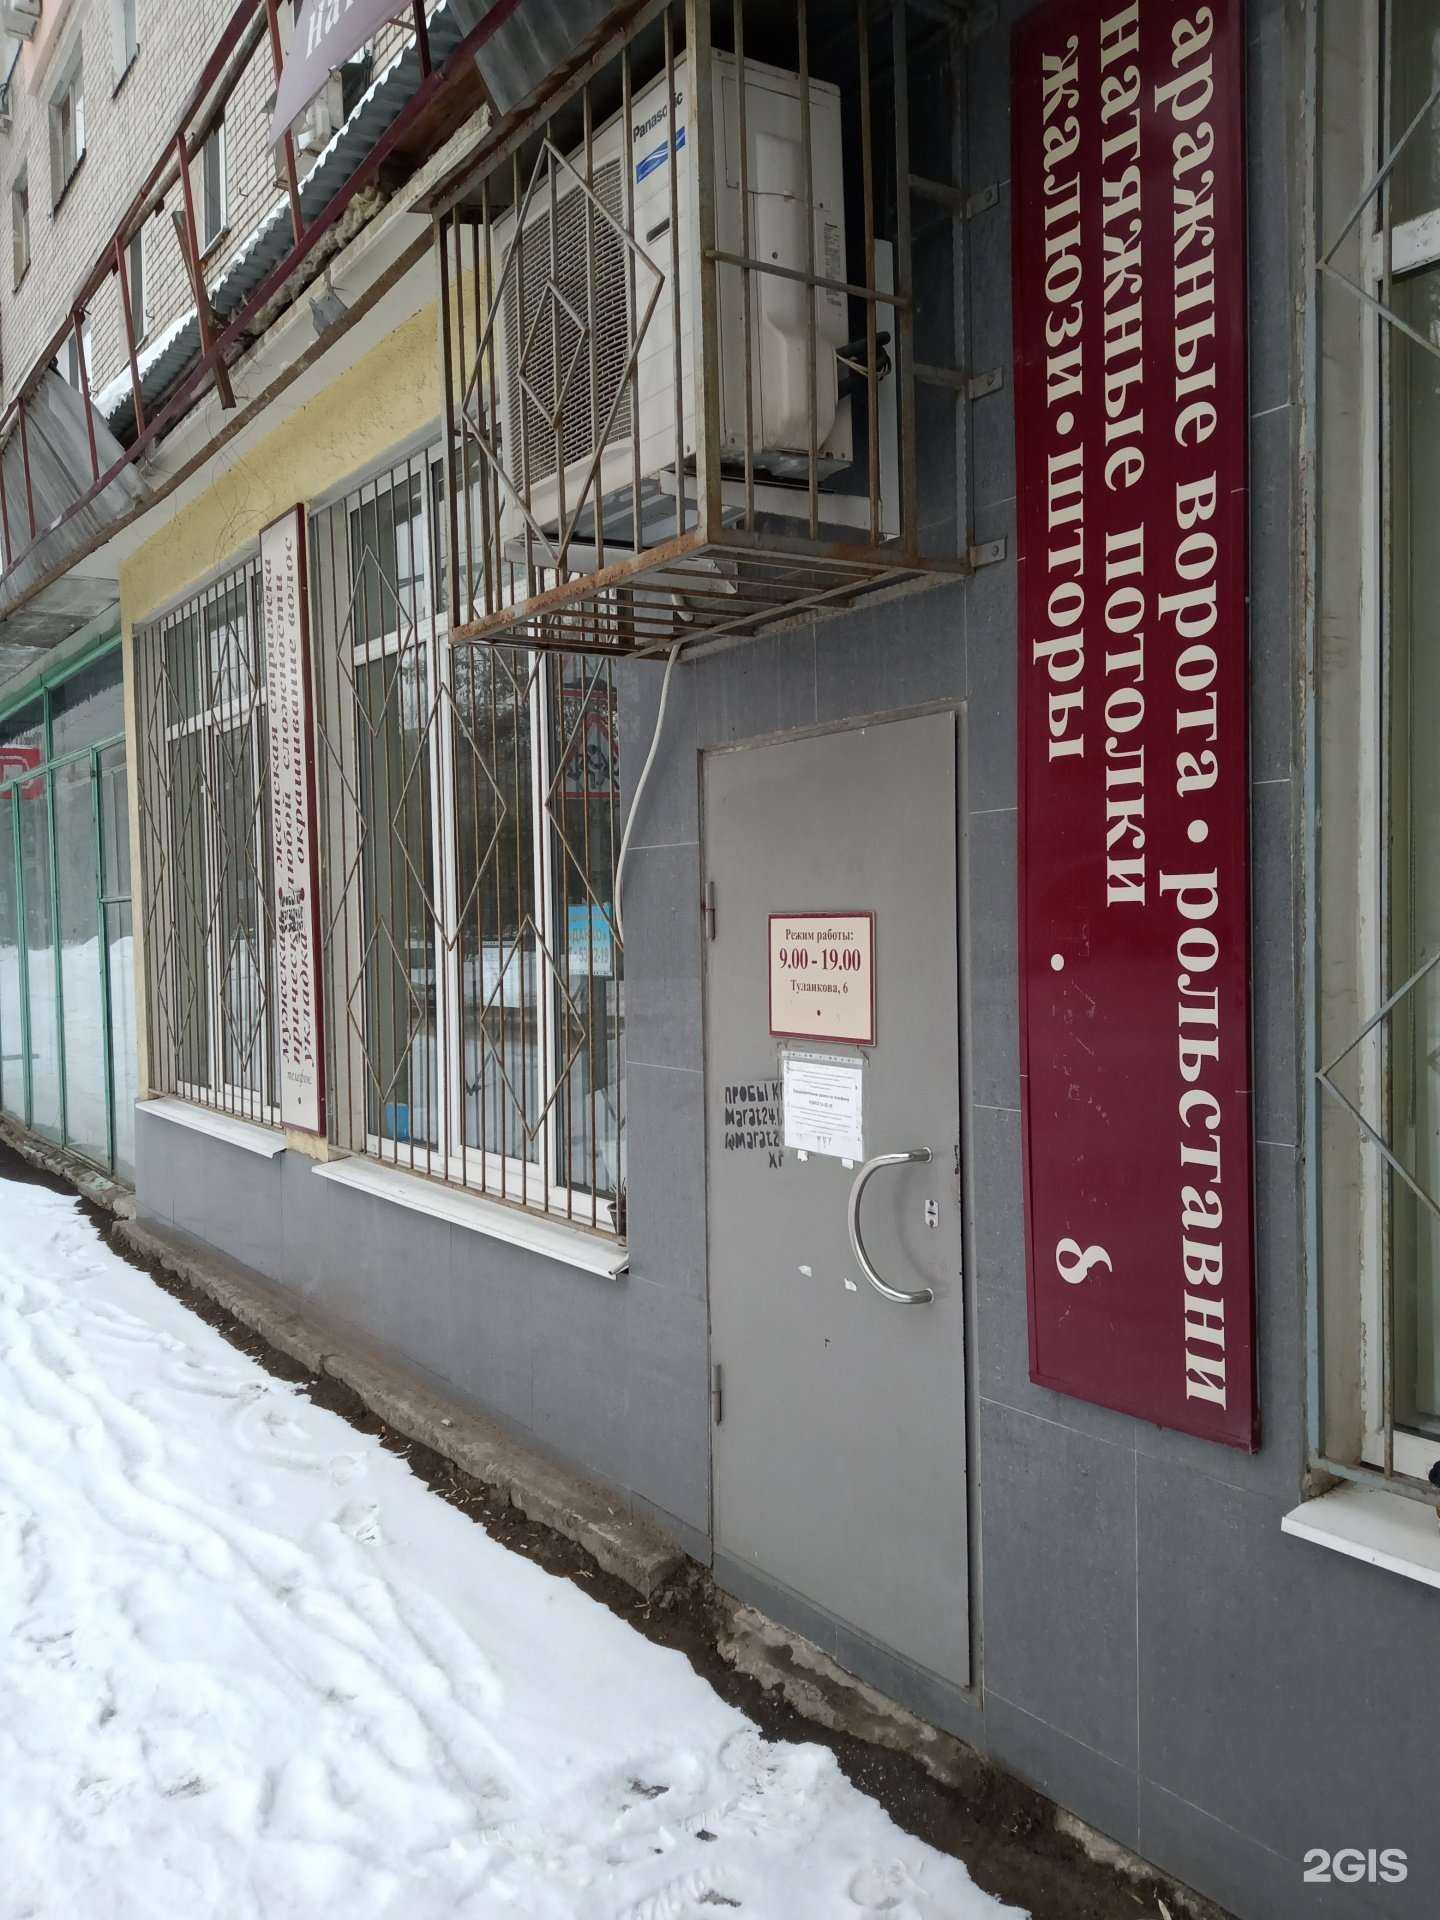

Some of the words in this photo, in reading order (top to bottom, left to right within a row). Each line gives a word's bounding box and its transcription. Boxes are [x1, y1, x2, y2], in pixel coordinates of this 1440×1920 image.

[633, 91, 684, 143] Panasoic
[1042, 35, 1083, 408] жалюзи
[1100, 0, 1145, 491] натяжные
[1155, 0, 1217, 447] аражные
[264, 558, 277, 714] стрижка
[285, 537, 296, 627] волос
[1033, 442, 1085, 763] шторы
[1158, 470, 1219, 798] ворота
[275, 575, 290, 770] сложности
[1104, 521, 1146, 908] потолки
[271, 726, 283, 867] женская
[288, 638, 305, 864] окрашивание
[282, 792, 294, 889] любой
[288, 924, 302, 1065] прическ
[299, 932, 315, 1068] укладка
[785, 928, 814, 941] Режим
[816, 928, 854, 943] работы:
[842, 982, 849, 994] 6
[772, 1082, 784, 1102] К
[1159, 867, 1227, 1411] рольставни
